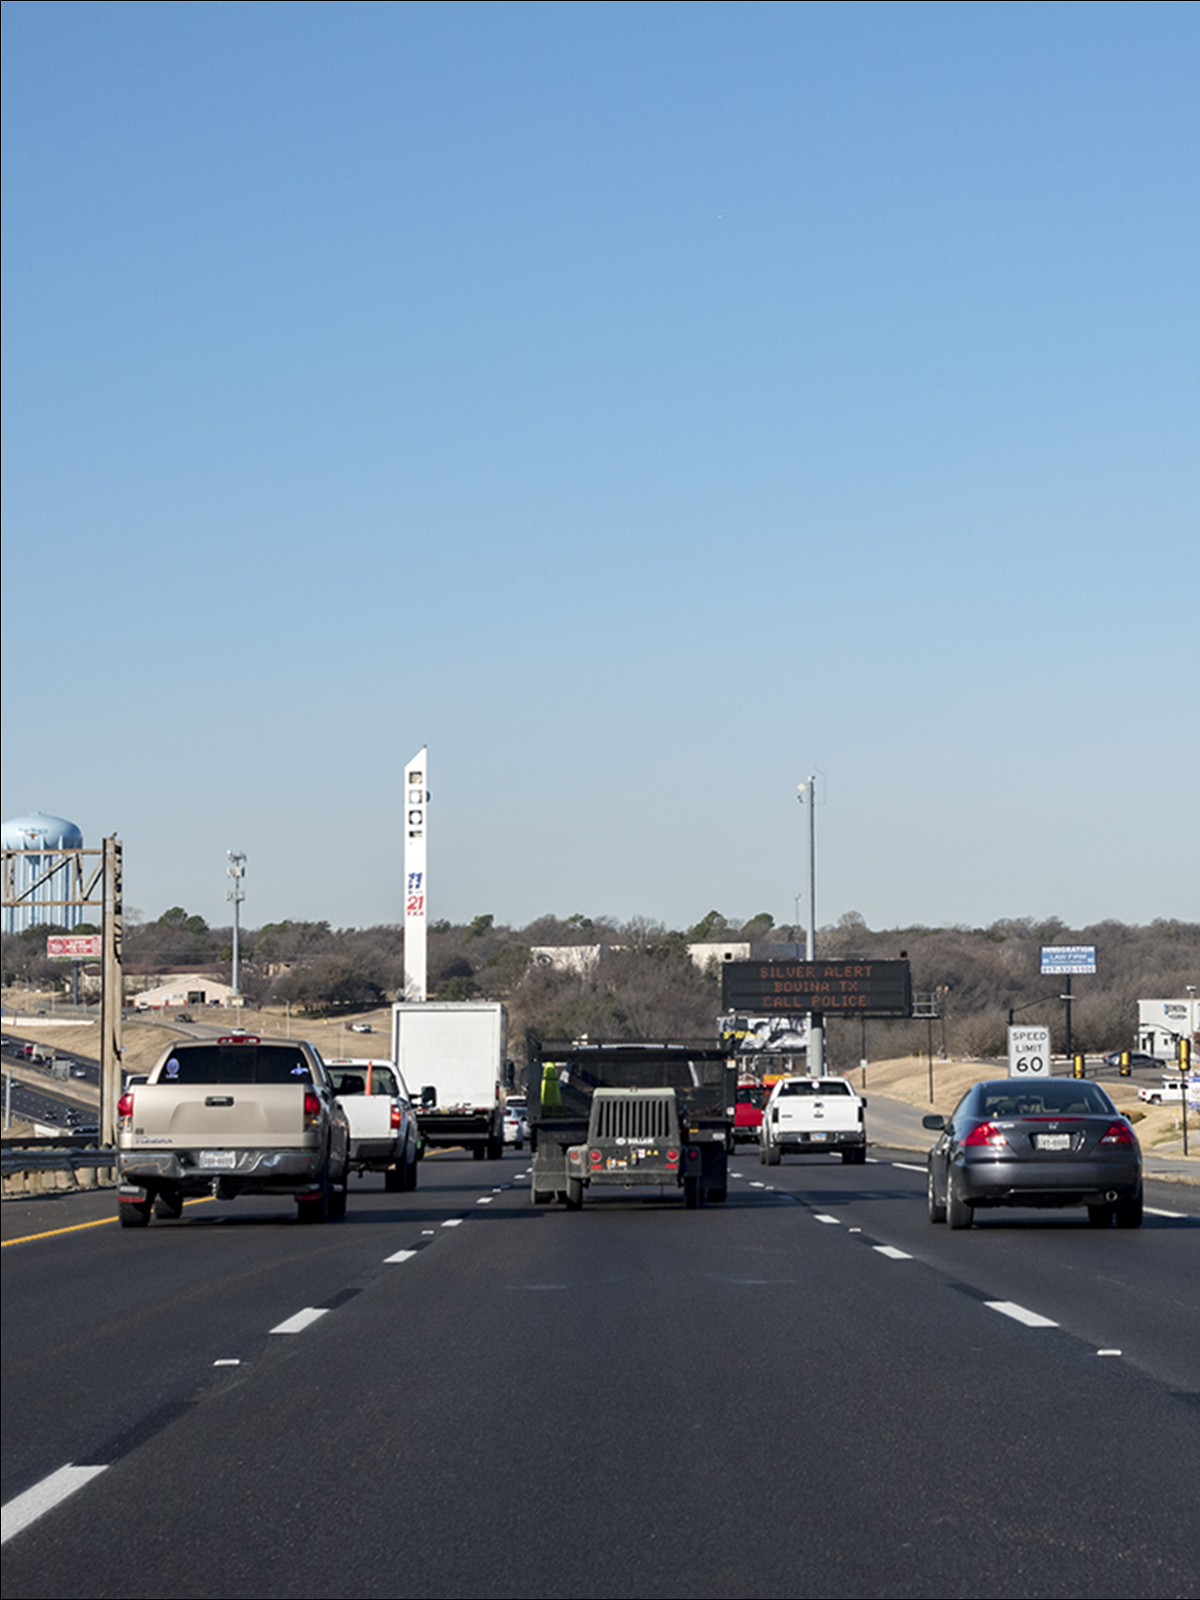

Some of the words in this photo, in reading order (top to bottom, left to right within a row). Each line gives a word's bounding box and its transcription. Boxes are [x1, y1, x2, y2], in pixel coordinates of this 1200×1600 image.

[407, 895, 424, 910] 21
[759, 966, 815, 978] SILVER
[824, 965, 873, 977] ALERT
[774, 981, 830, 993] BOVINA
[839, 981, 858, 991] TX
[763, 996, 801, 1008] CALL
[811, 995, 867, 1007] POLICE
[1012, 1032, 1047, 1041] SPEED
[1016, 1044, 1043, 1053] LIMIT
[1016, 1056, 1043, 1072] 60
